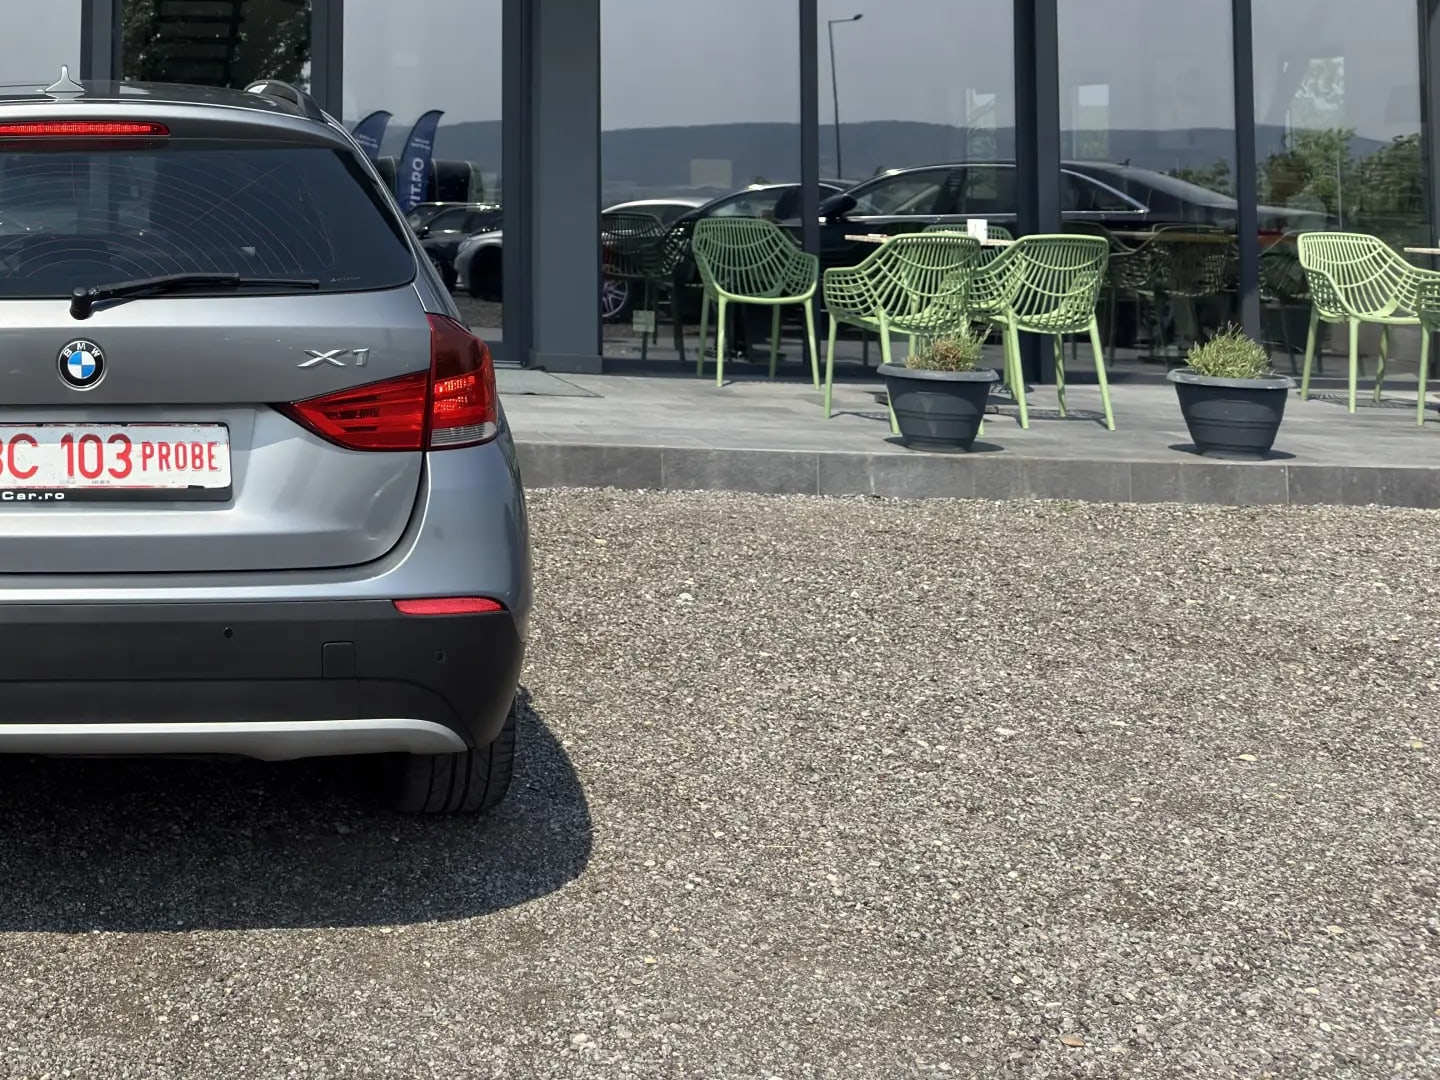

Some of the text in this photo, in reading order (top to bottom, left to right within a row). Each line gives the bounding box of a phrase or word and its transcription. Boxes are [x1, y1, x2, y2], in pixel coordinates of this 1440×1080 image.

[63, 342, 101, 358] BMW
[297, 347, 370, 369] X1
[60, 432, 133, 480] 103
[140, 440, 220, 472] PROBE
